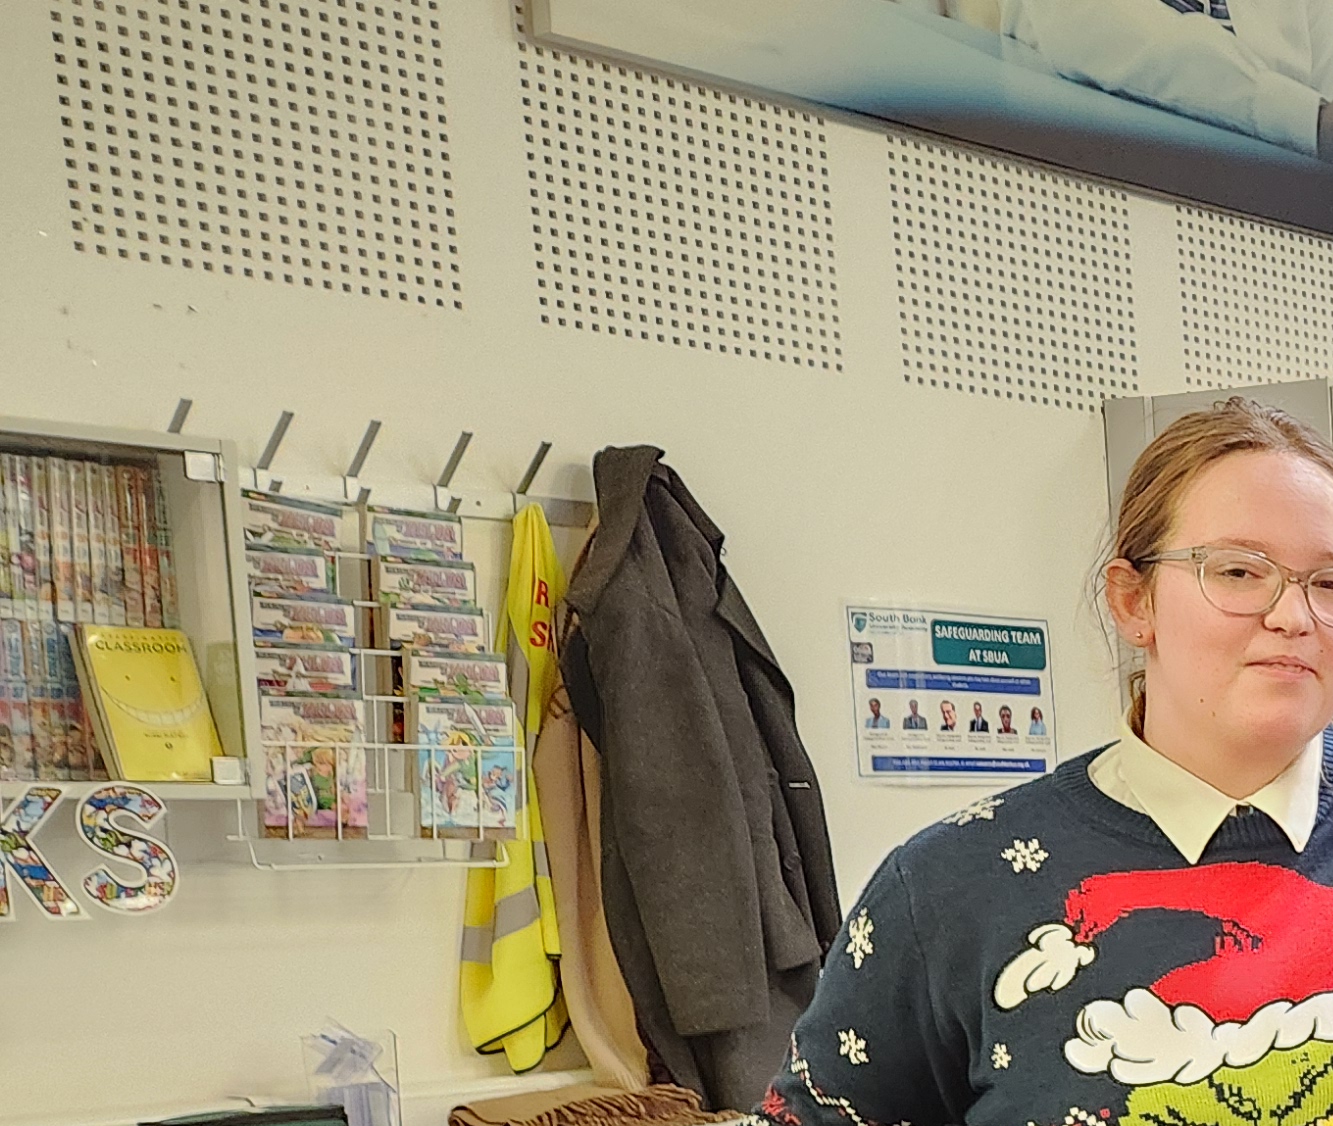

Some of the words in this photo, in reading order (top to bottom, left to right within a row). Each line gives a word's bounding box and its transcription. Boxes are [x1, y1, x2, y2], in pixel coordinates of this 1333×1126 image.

[869, 612, 900, 623] South
[902, 614, 927, 624] Bank
[934, 625, 1009, 643] SAFEGUARDING
[1011, 631, 1042, 645] TEAM
[95, 640, 187, 655] CLASSROOM
[969, 649, 981, 662] AT
[982, 650, 1010, 665] SBUA
